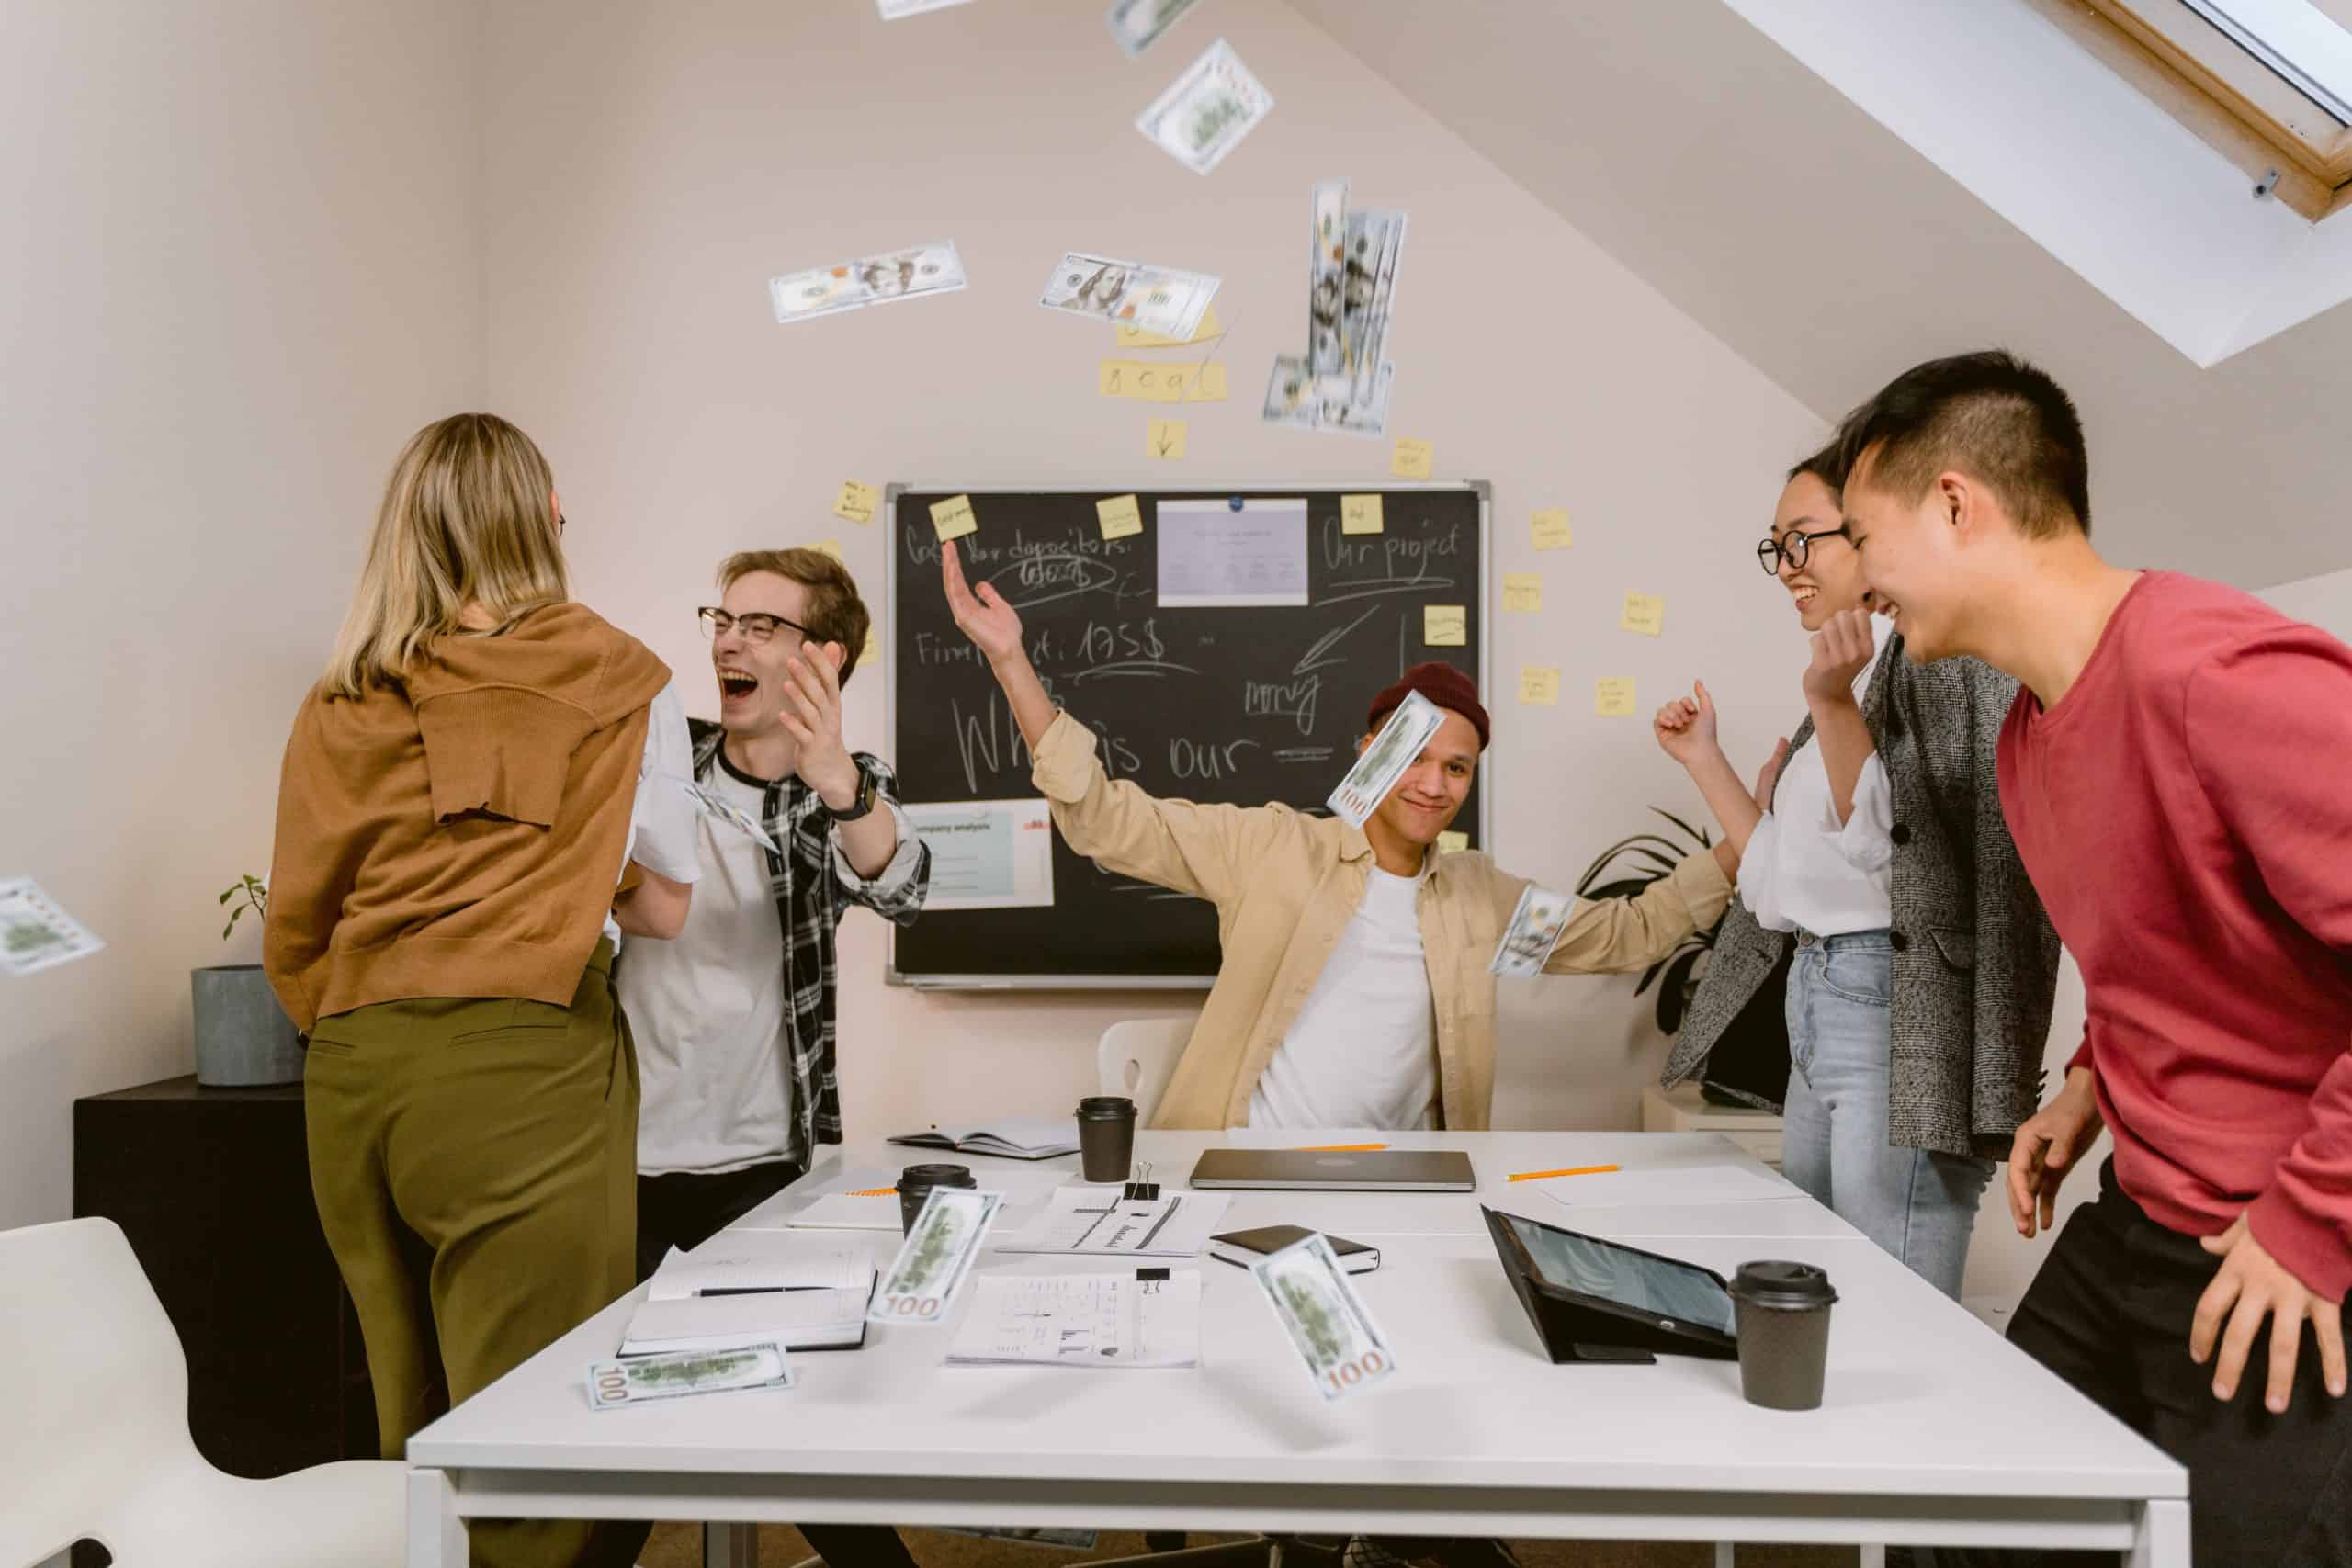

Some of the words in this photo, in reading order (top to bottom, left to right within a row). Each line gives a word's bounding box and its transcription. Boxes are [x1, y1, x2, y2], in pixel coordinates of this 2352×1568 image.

[1384, 517, 1460, 586] project
[1169, 736, 1261, 779] our
[885, 1295, 939, 1317] 100
[1328, 1350, 1384, 1391] 100
